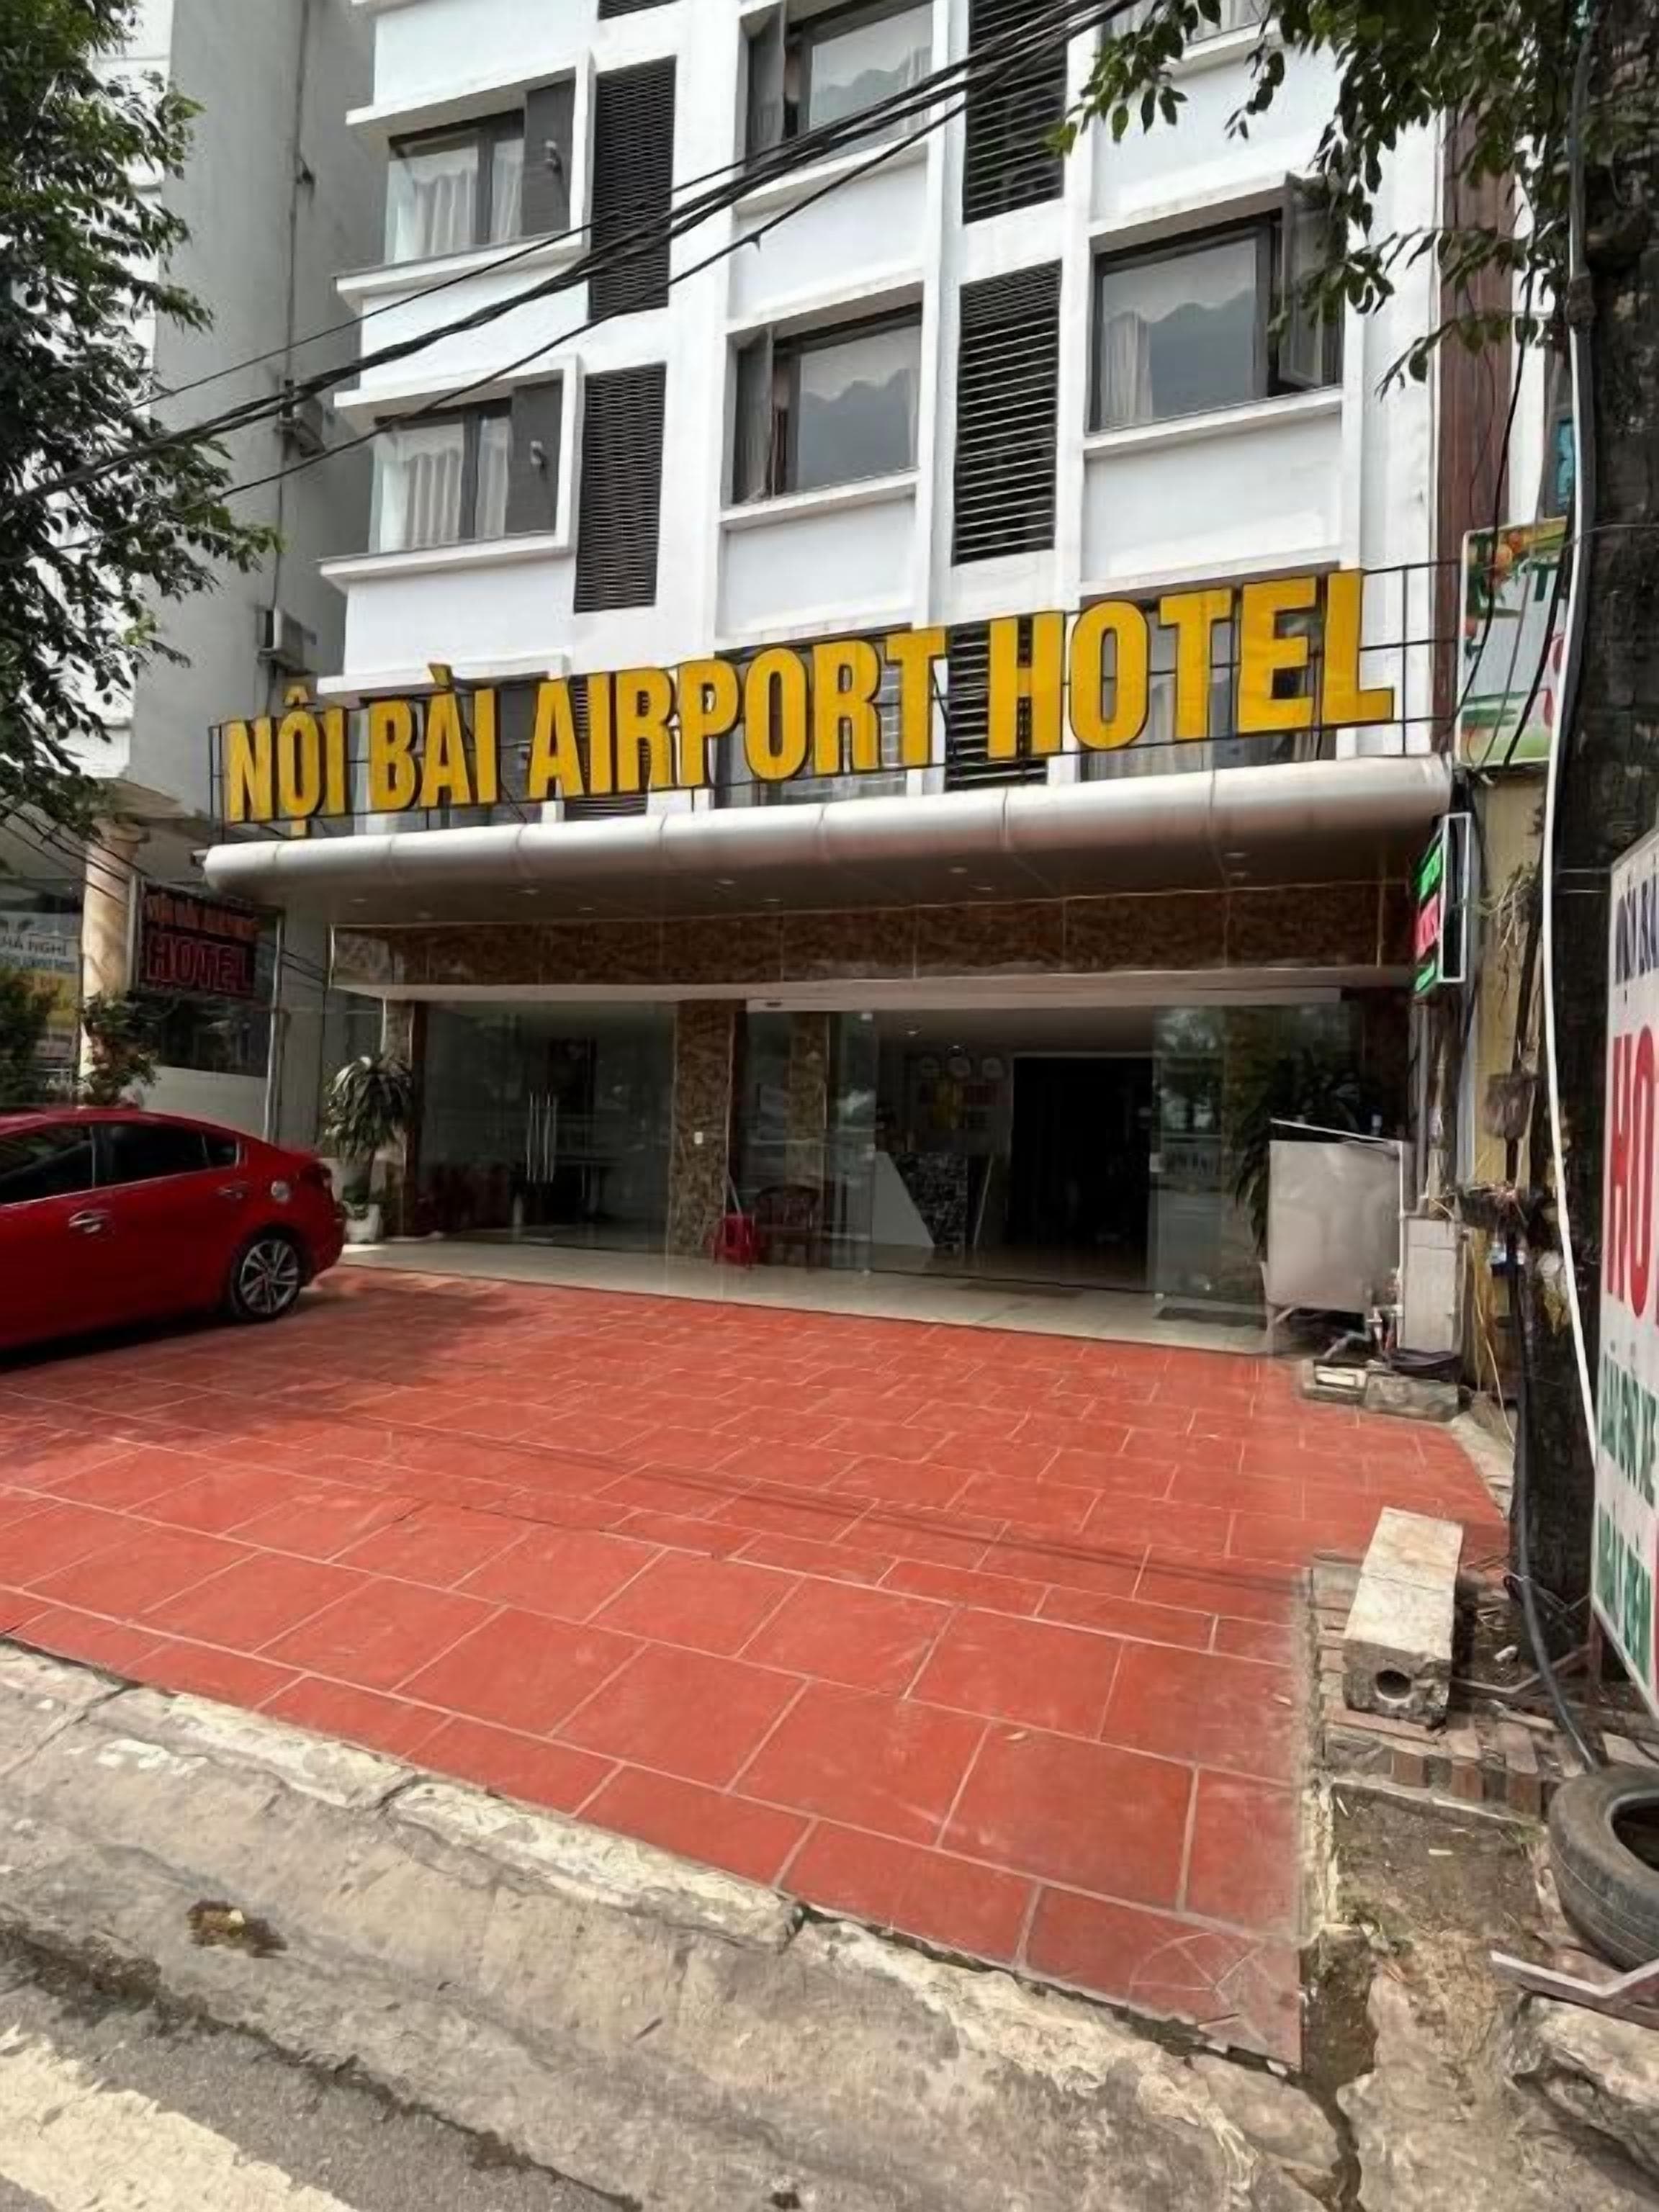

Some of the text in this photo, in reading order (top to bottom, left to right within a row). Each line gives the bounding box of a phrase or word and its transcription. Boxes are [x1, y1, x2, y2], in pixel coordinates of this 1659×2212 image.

[228, 567, 1394, 838] NỘI BÀI AIRPORT HOTEL
[1607, 1026, 1659, 1325] HO
